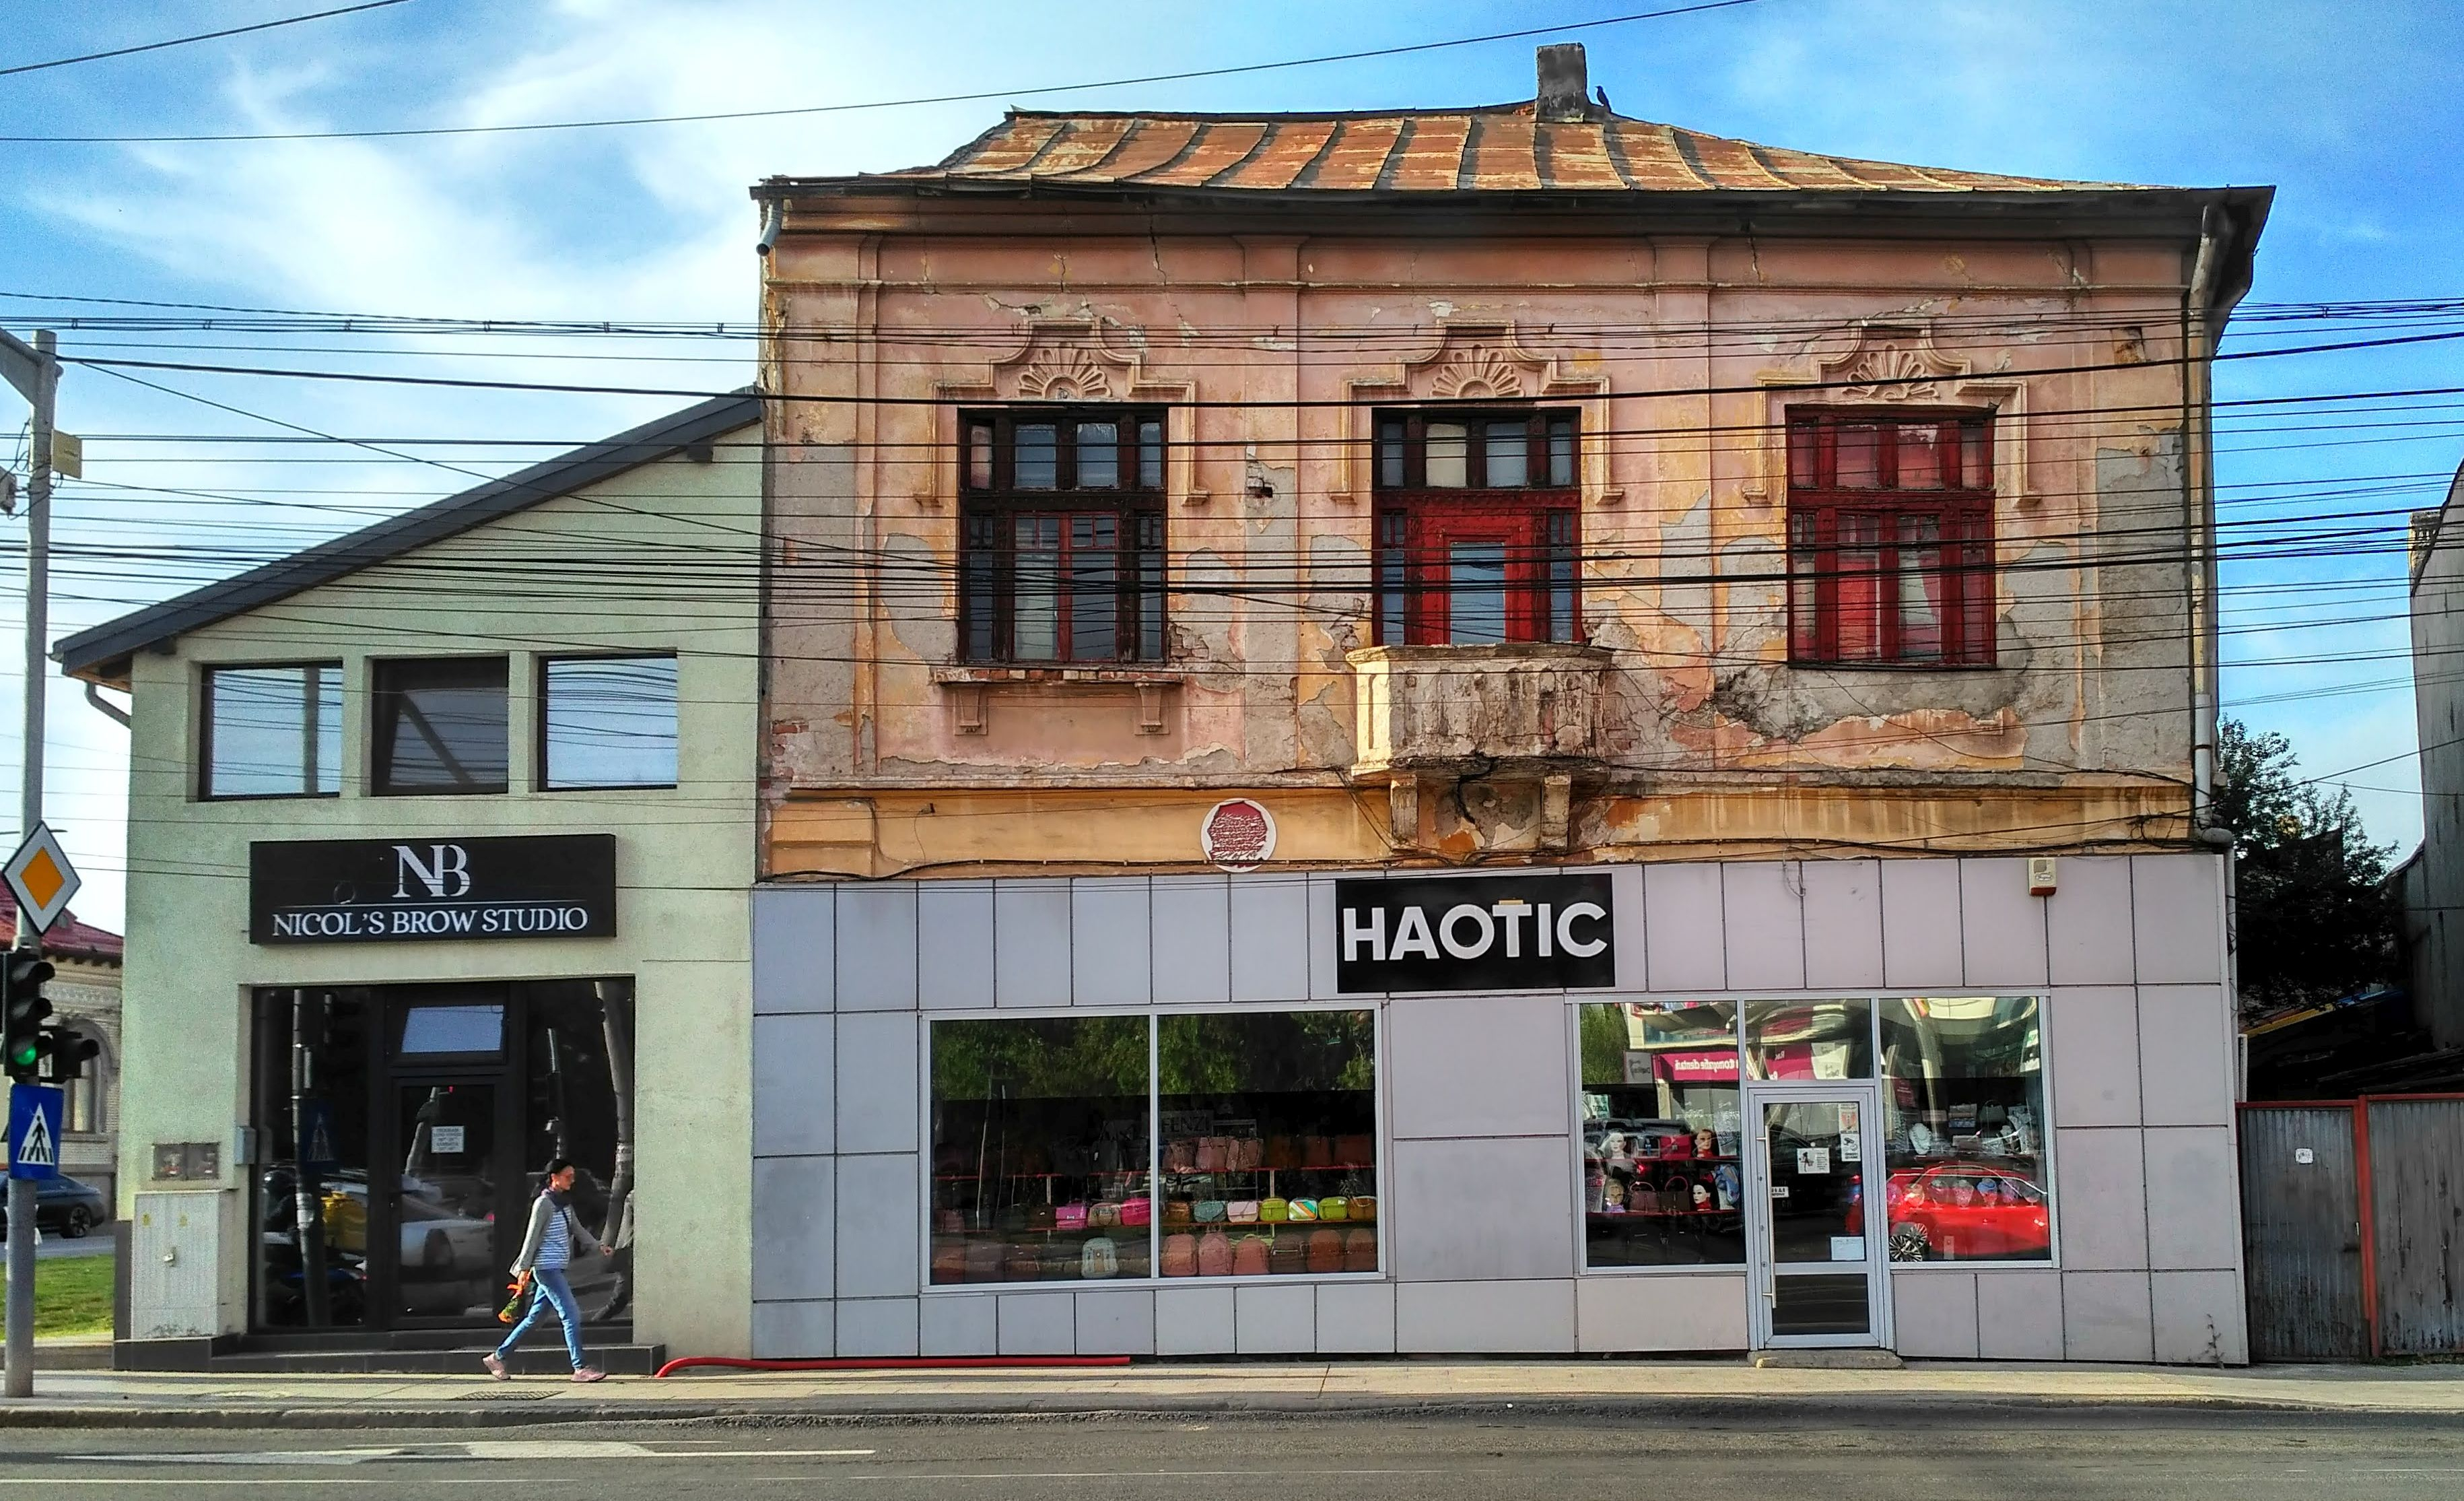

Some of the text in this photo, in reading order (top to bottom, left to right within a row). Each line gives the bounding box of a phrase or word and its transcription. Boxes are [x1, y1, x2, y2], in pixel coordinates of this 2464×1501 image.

[391, 844, 471, 898] NB
[272, 907, 588, 936] NICOL'S BROW STUDIO
[1343, 902, 1608, 962] HAOTIC
